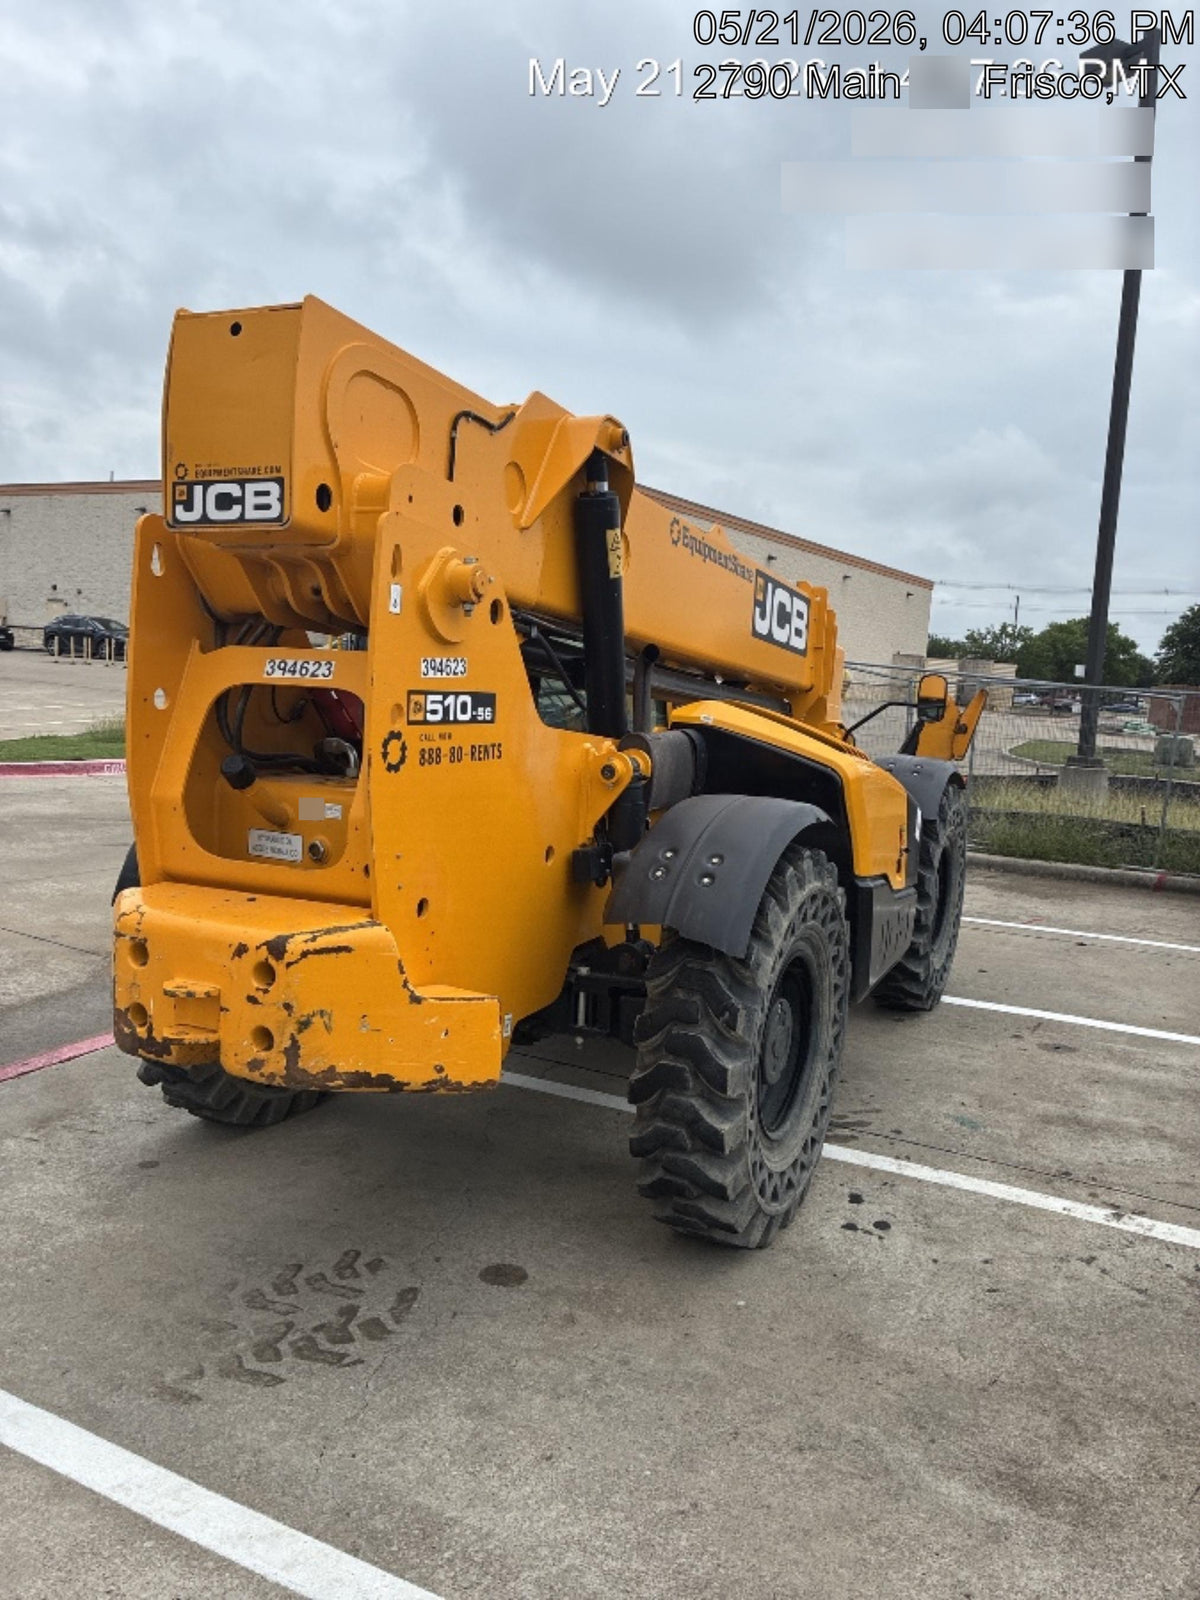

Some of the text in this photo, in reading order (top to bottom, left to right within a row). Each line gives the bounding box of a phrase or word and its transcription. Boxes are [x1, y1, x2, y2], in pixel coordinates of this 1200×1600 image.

[175, 481, 281, 522] JCB
[754, 582, 808, 650] JCB
[265, 659, 334, 678] 394623
[422, 658, 467, 676] 394623
[426, 694, 493, 721] 510-56
[419, 742, 502, 767] 888-80-RENTS
